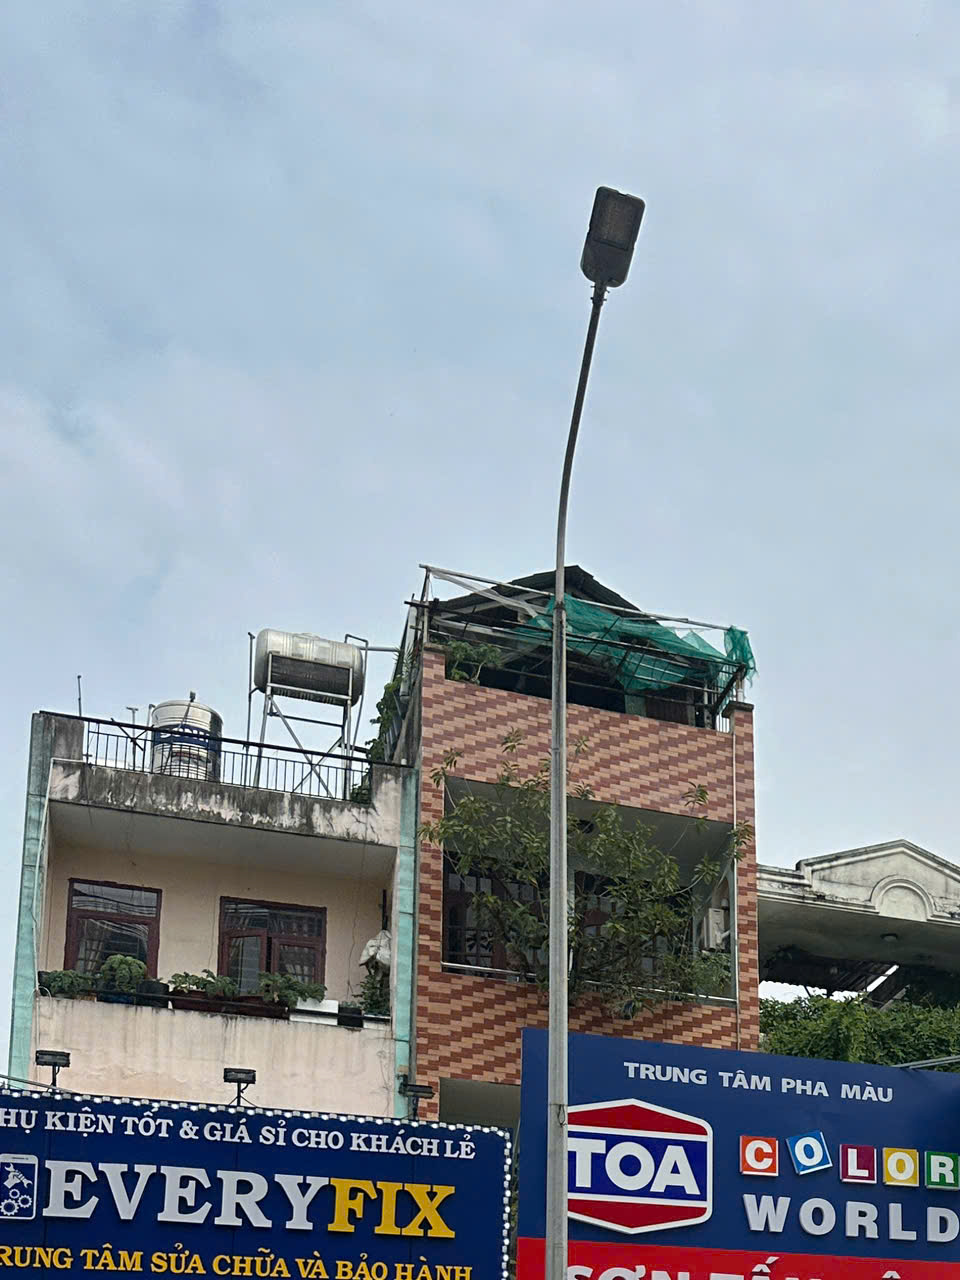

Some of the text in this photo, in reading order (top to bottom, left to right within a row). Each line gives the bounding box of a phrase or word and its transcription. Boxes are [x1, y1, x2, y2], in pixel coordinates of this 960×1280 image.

[624, 1061, 893, 1103] TRUNG TÂM PHA MÀU
[44, 1106, 116, 1138] KIỆN
[121, 1107, 173, 1138] TỐT
[179, 1120, 199, 1140] &
[203, 1118, 252, 1143] GIÁ
[259, 1119, 287, 1146] SỈ
[291, 1128, 344, 1150] CHO
[350, 1129, 439, 1157] KHÁCH
[444, 1134, 476, 1160] LẺ
[567, 1137, 701, 1195] TOA
[744, 1135, 957, 1186] COLOR
[42, 1160, 456, 1239] EVERYFIX
[743, 1194, 960, 1243] WORLD
[80, 1243, 144, 1272] TÂM
[151, 1242, 207, 1275] SỬA
[213, 1247, 291, 1279] CHỮA
[295, 1250, 330, 1280] VÀ
